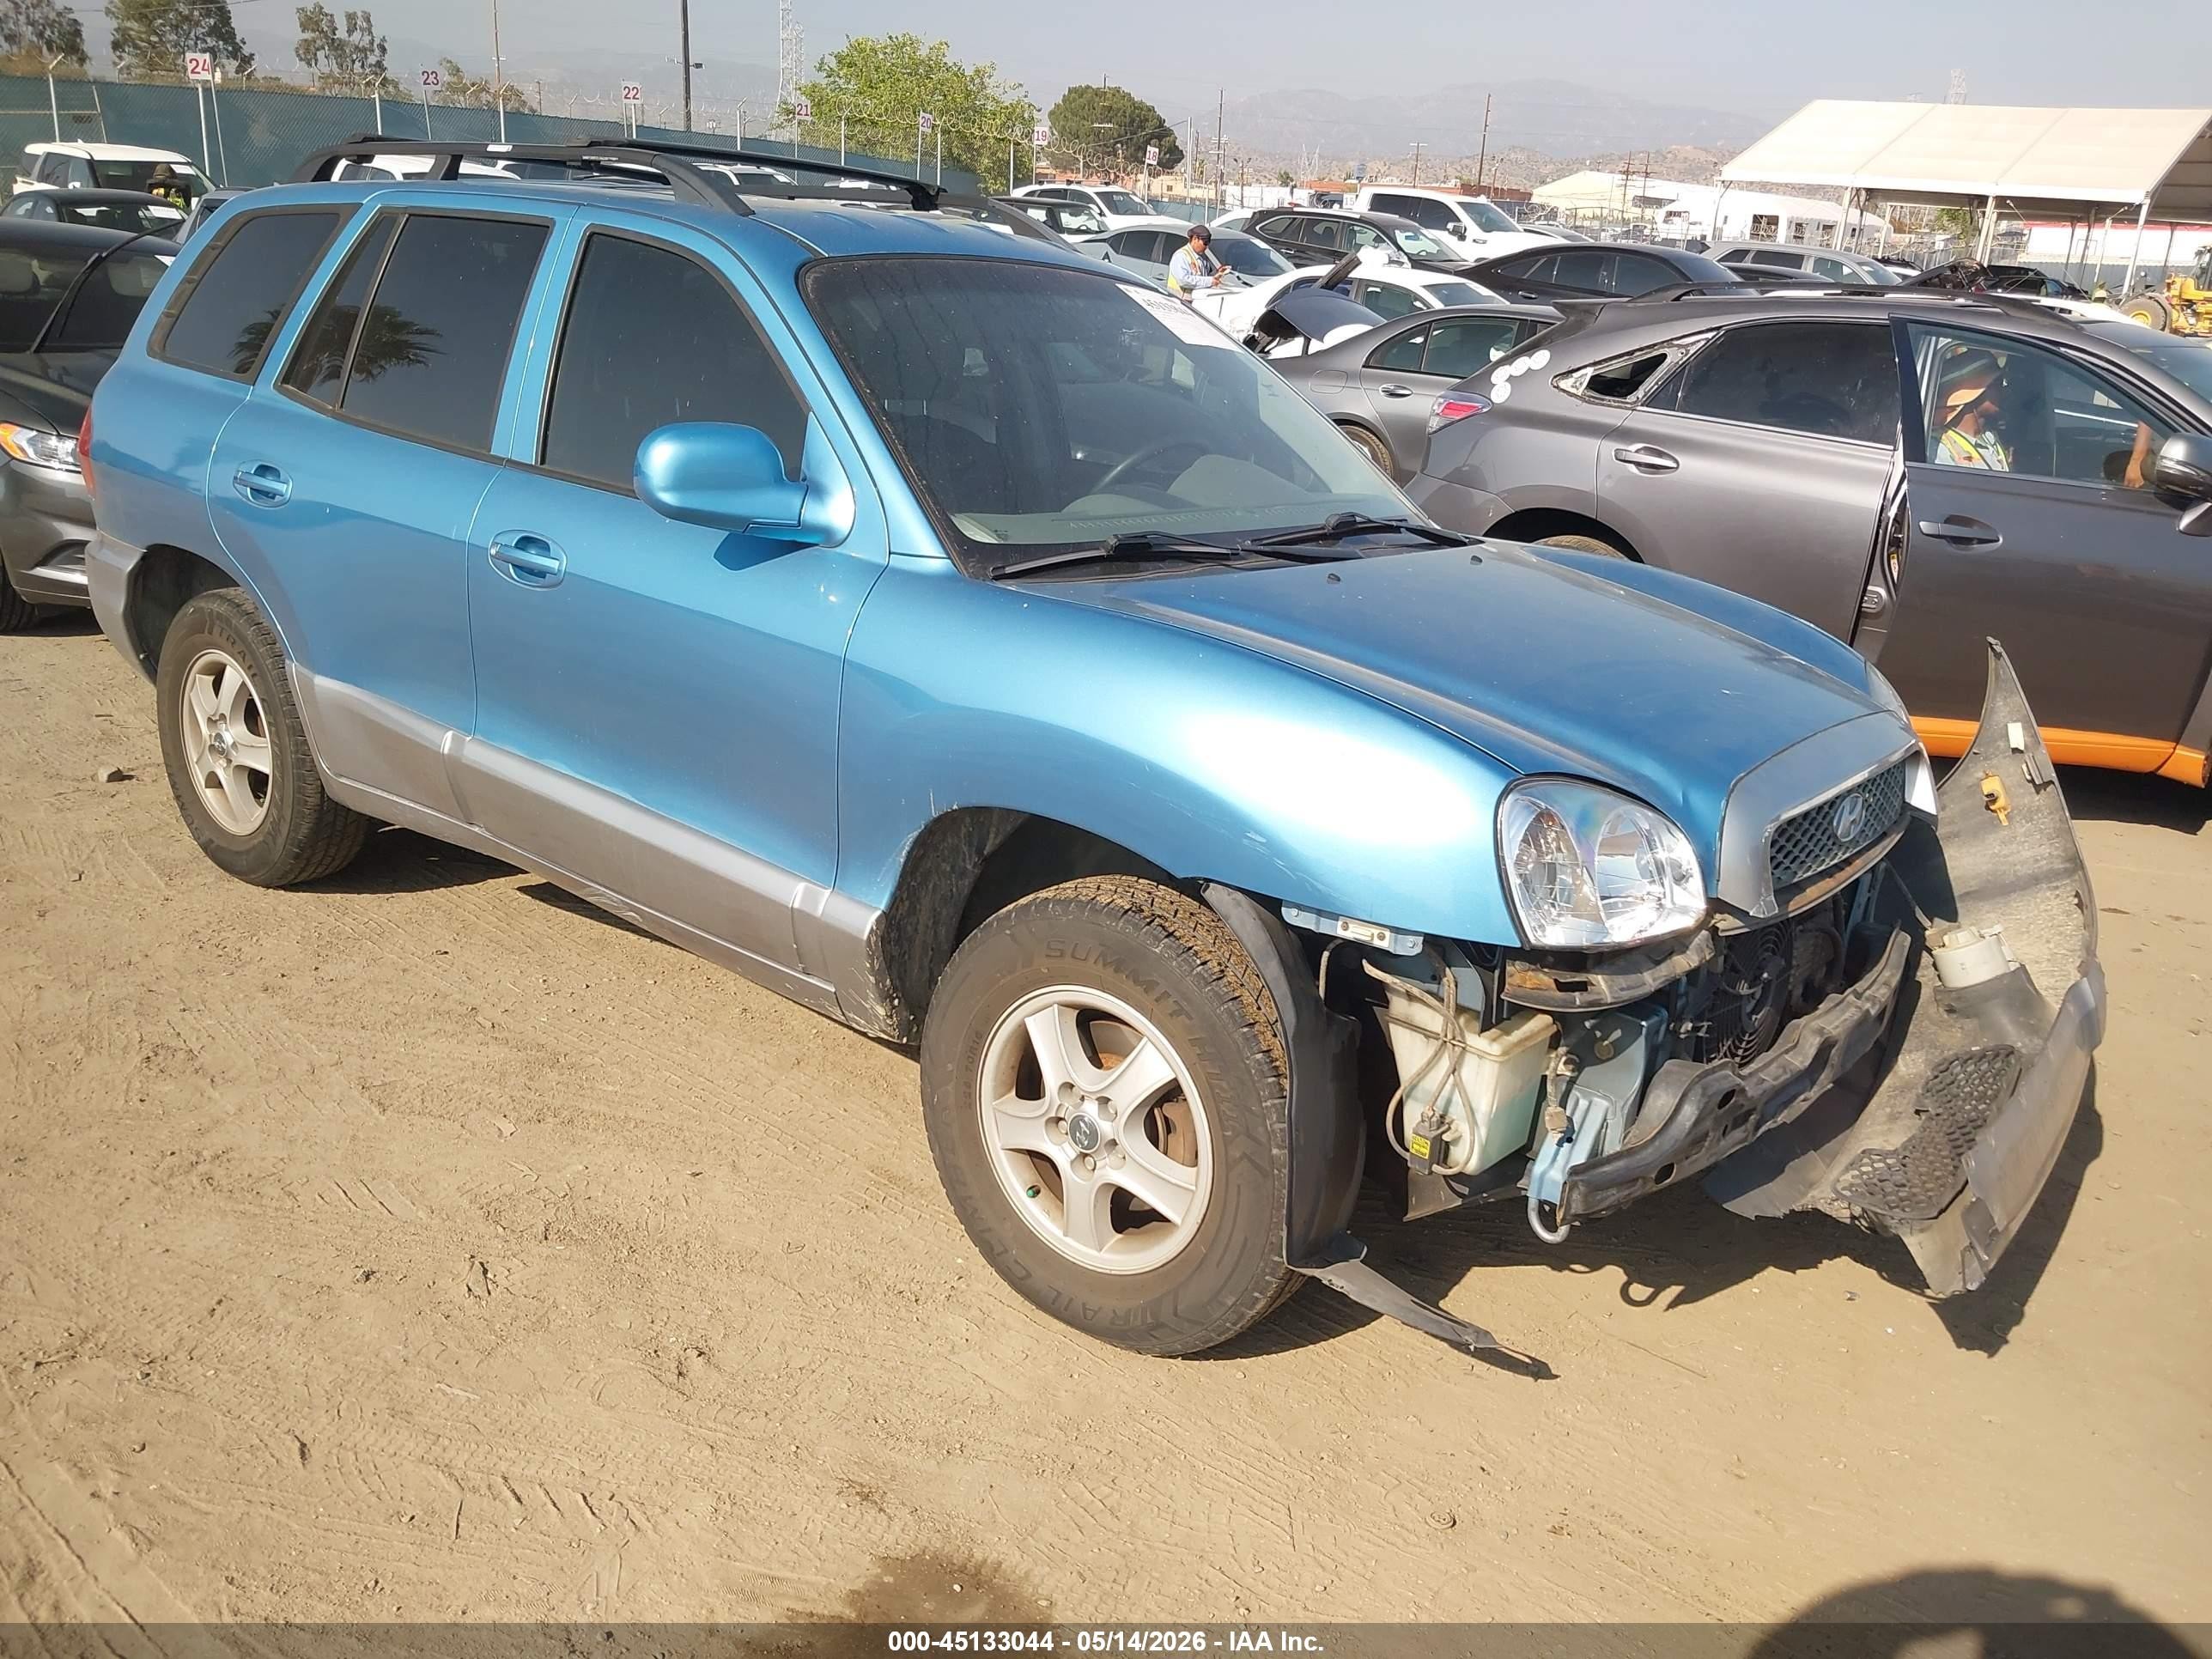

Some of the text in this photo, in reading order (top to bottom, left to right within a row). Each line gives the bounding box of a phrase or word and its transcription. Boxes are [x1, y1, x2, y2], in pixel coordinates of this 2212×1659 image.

[188, 58, 210, 75] 24
[422, 71, 440, 86] 23
[623, 86, 640, 100] 22
[796, 103, 811, 117] 21
[921, 116, 932, 130] 20
[1036, 131, 1048, 142] 19
[1147, 149, 1158, 162] 18
[1045, 939, 1194, 1022] SUMMIT
[1047, 1284, 1158, 1328] TRAIL
